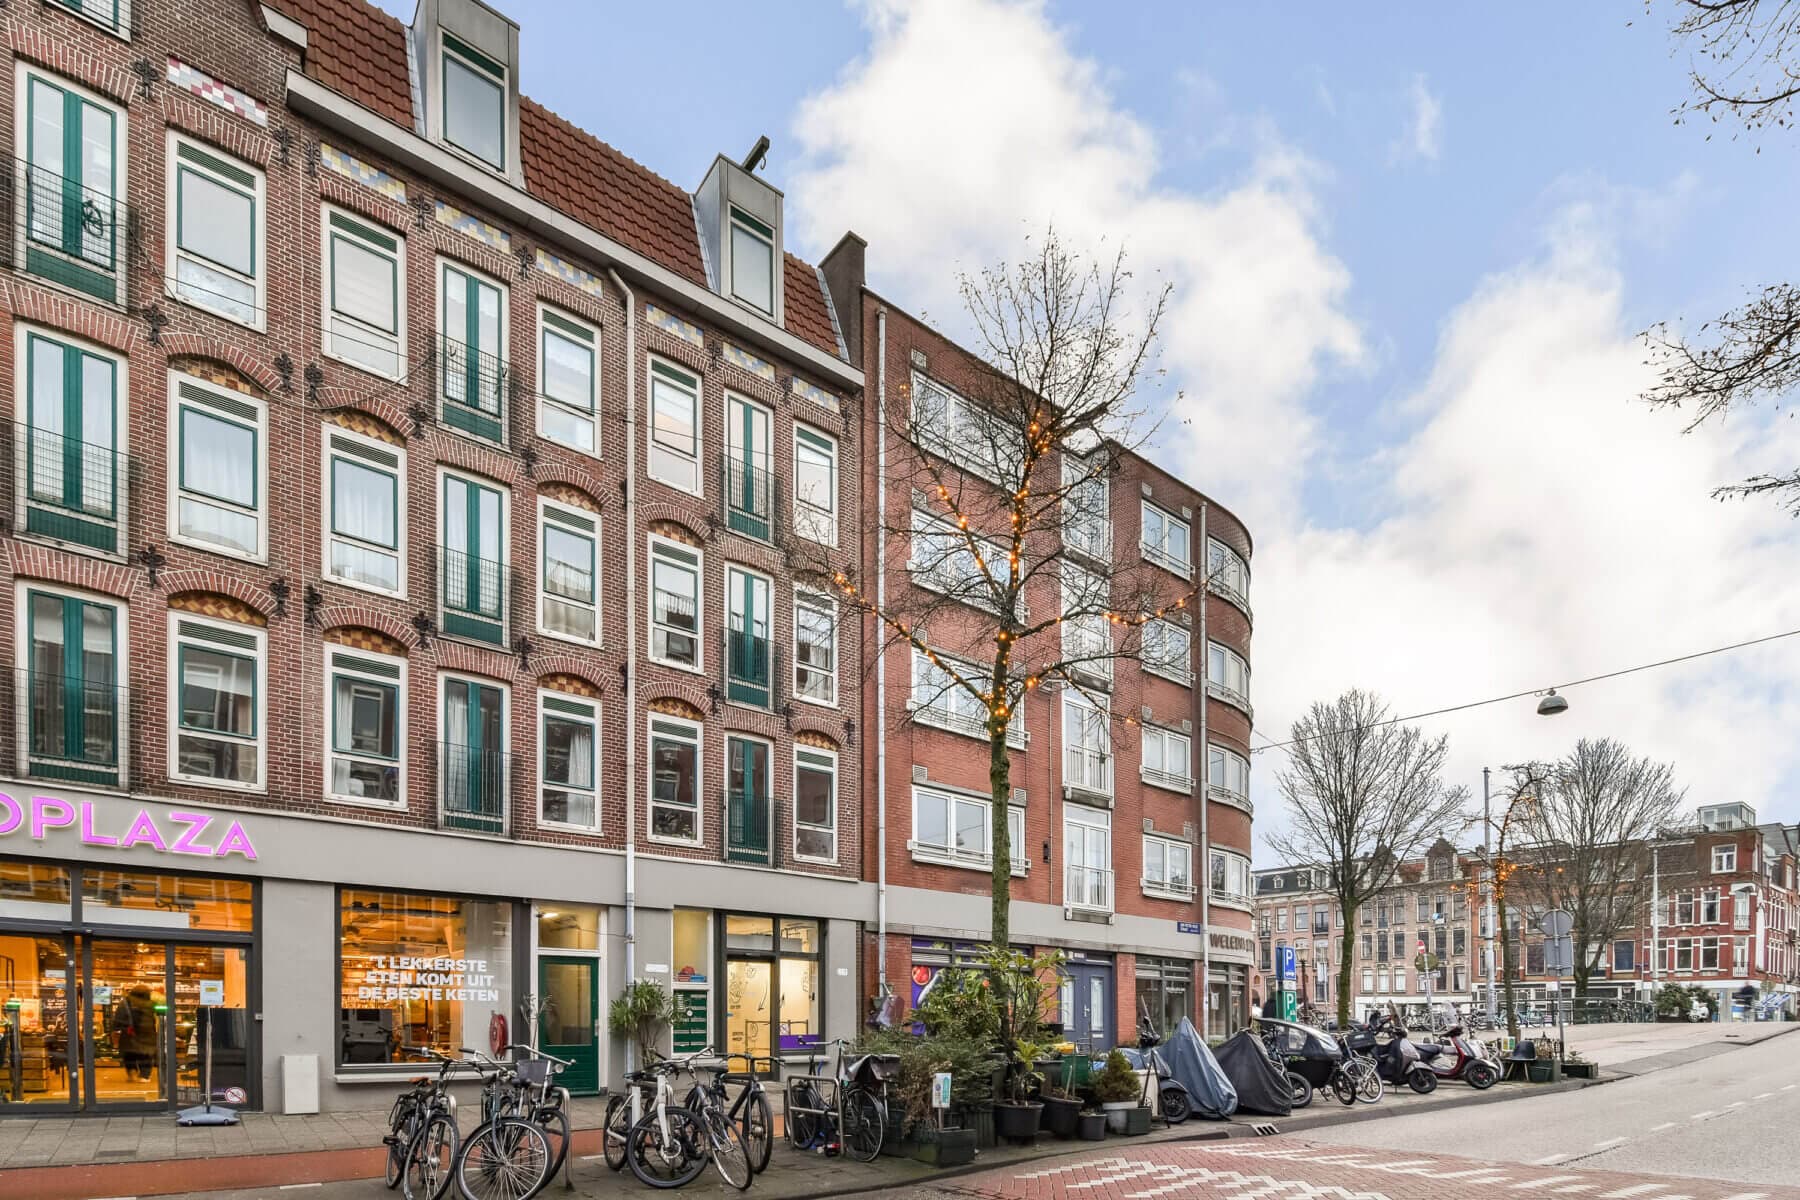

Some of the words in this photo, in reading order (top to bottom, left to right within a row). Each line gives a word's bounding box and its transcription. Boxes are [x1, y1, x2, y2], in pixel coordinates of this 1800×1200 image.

[389, 957, 487, 972] LEKKERSTE
[1286, 950, 1293, 966] P
[366, 970, 412, 984] ETEN
[416, 972, 465, 986] KOMT
[467, 974, 494, 987] UIT
[358, 986, 382, 1000] DE
[386, 987, 443, 1000] BESTE
[446, 988, 499, 1001] KETEN
[1286, 993, 1294, 1010] P
